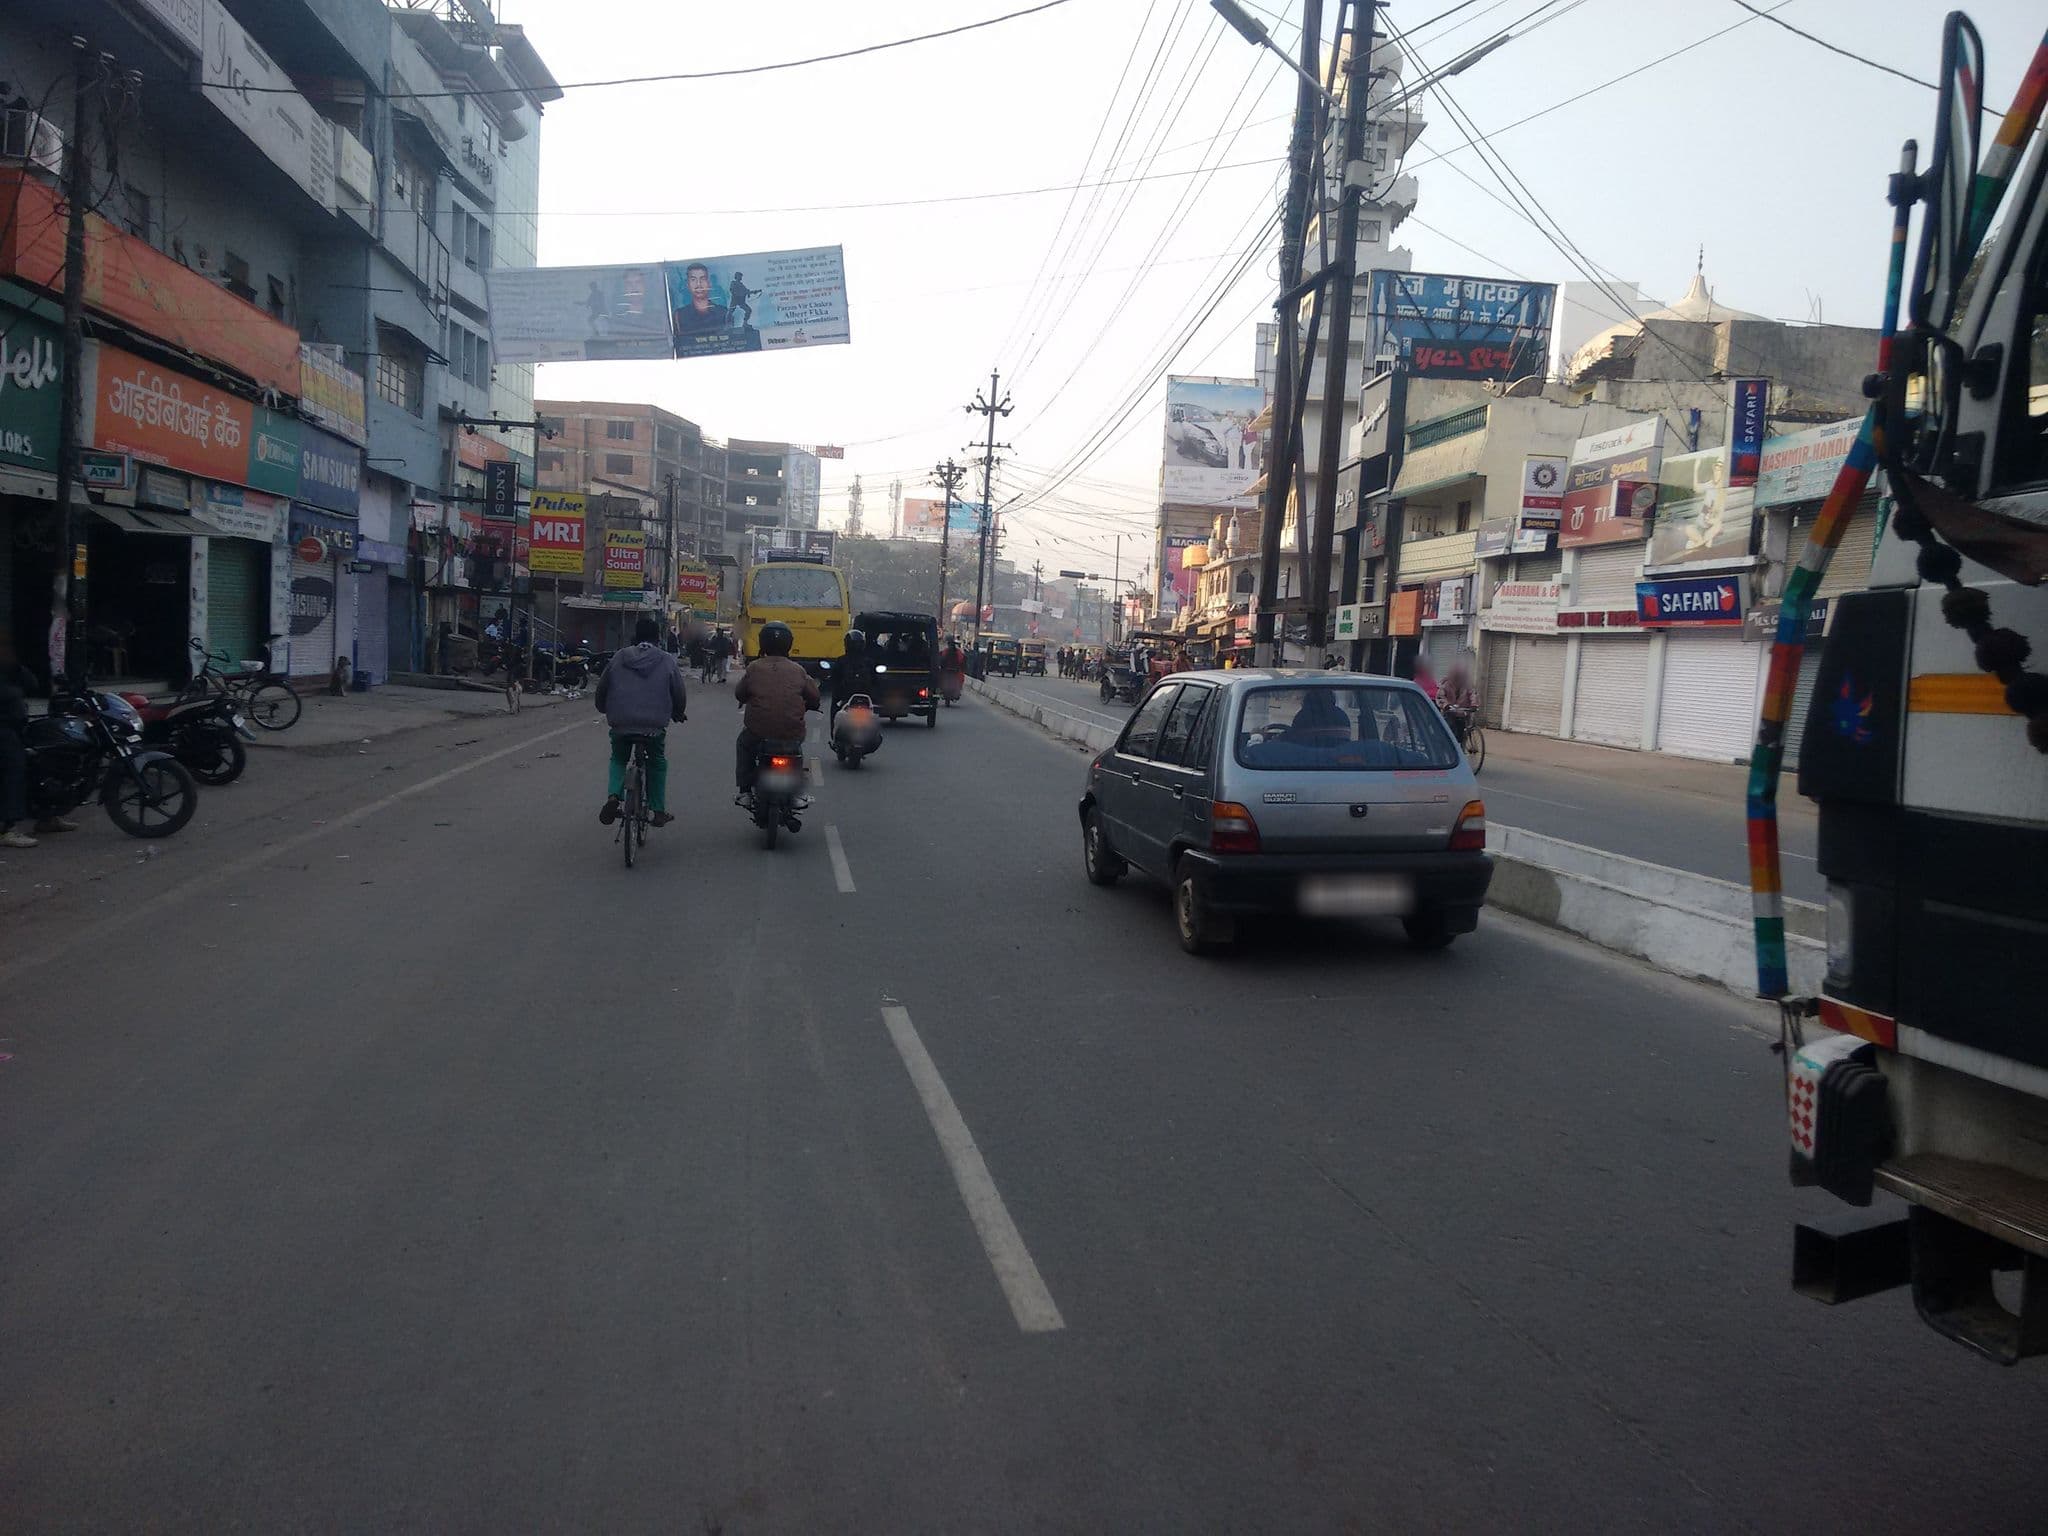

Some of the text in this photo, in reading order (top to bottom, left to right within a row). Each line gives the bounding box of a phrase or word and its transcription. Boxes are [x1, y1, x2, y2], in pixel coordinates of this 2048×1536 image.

[1744, 396, 1757, 443] SAFARI
[89, 466, 116, 477] ATM
[302, 450, 359, 491] SAMSUNG
[495, 464, 506, 514] SONY
[533, 496, 583, 511] Pulse
[533, 521, 581, 542] MRI
[607, 532, 642, 544] Pulse
[609, 548, 640, 560] Ultra
[606, 559, 641, 571] Sound
[680, 578, 706, 588] X-Ray
[1661, 591, 1719, 613] SAFARI
